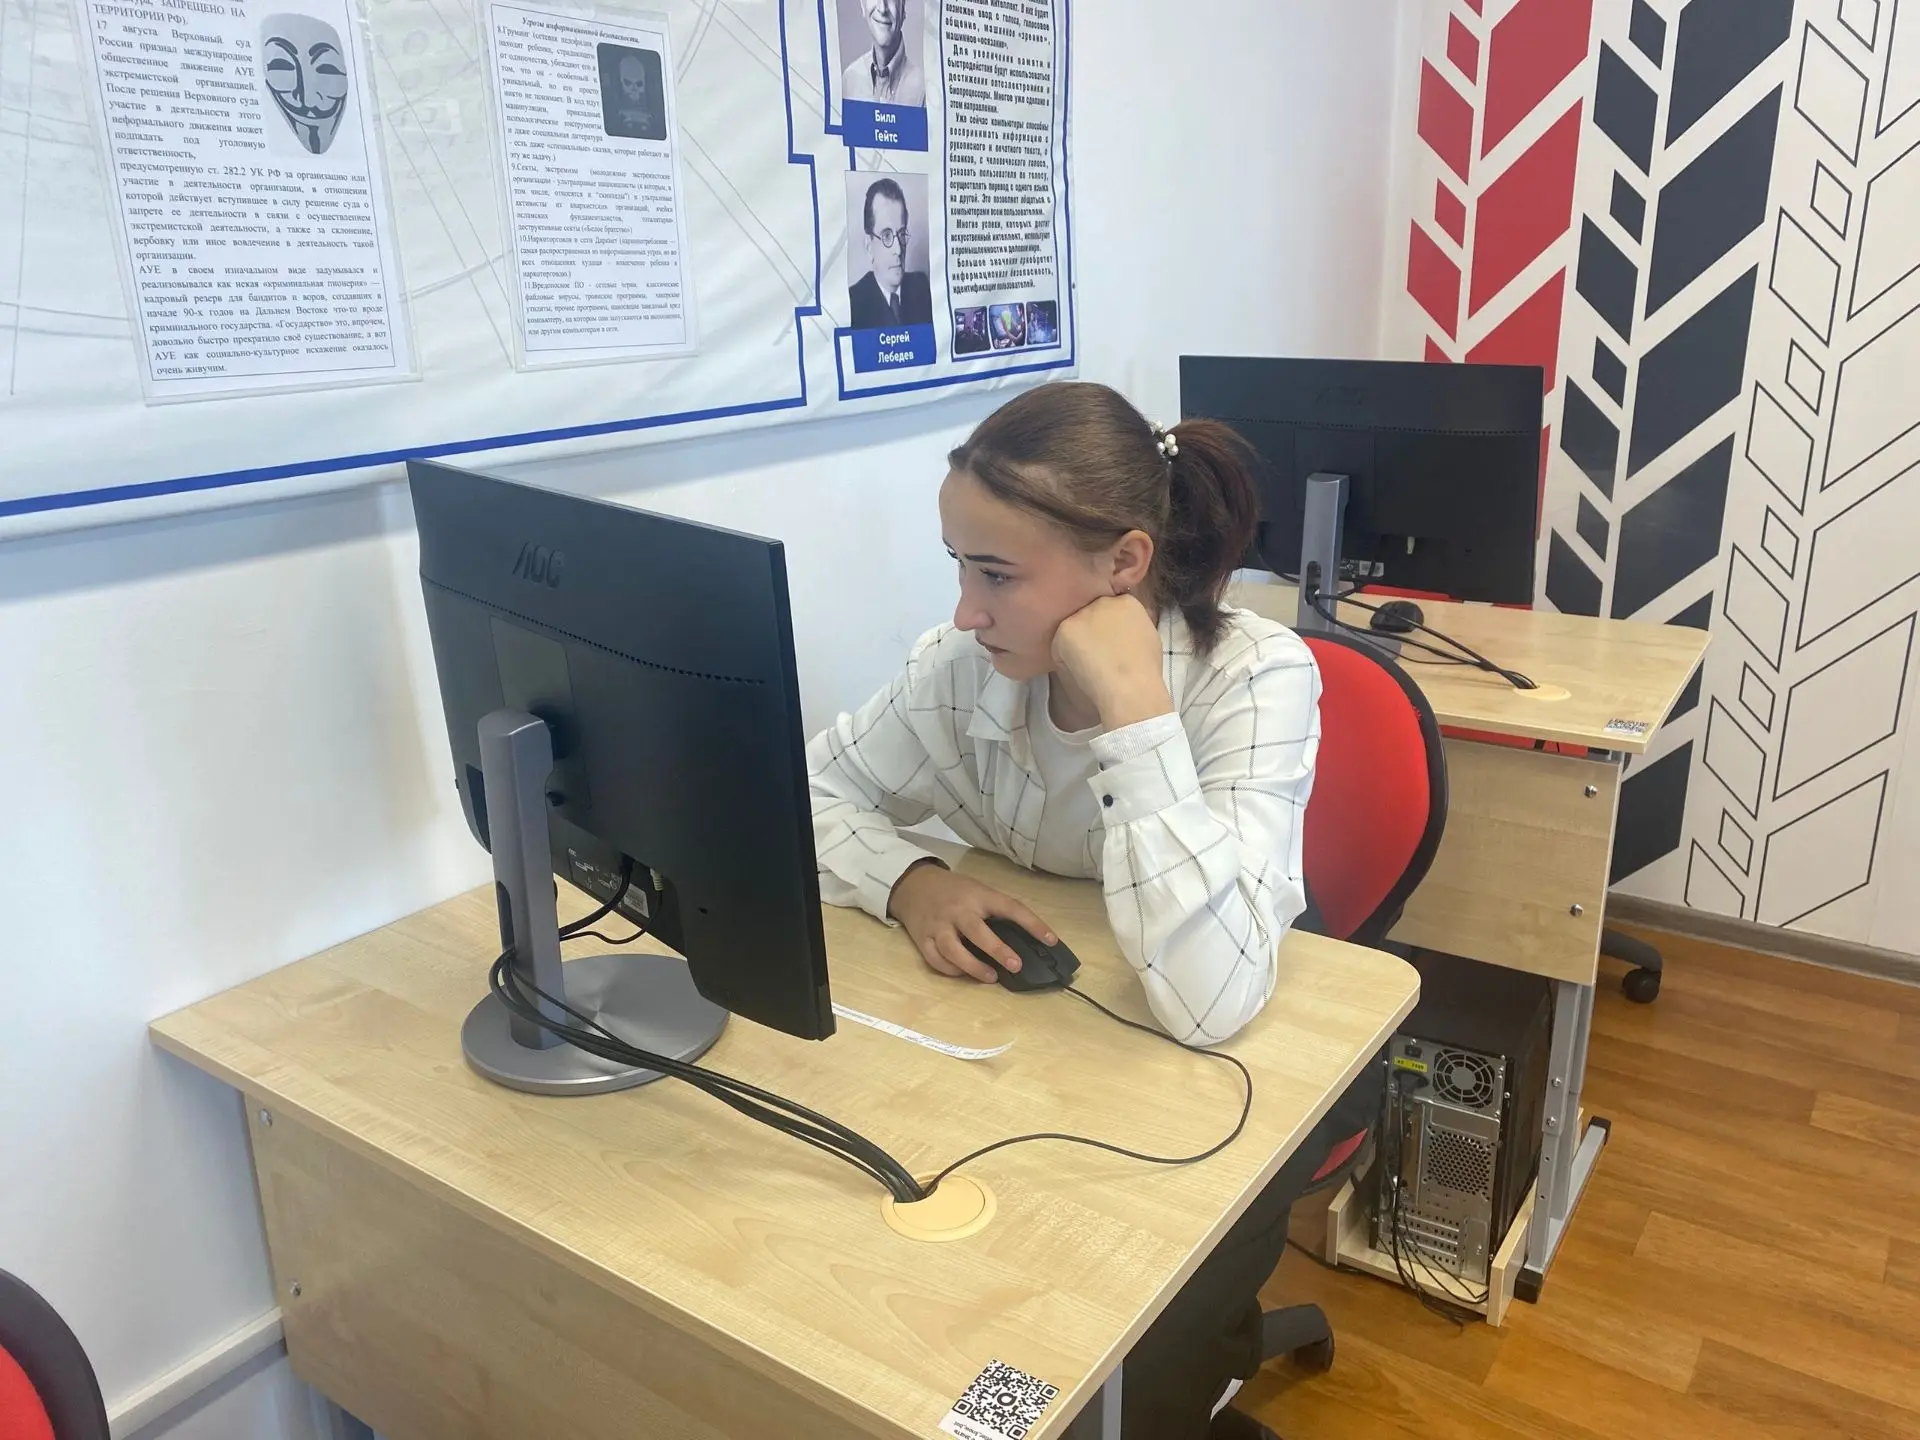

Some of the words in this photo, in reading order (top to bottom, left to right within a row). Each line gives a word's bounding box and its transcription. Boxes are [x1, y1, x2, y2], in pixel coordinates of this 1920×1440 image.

[93, 3, 165, 21] ТЕРРИТОРИИ
[122, 25, 158, 36] августа
[171, 28, 223, 43] Верховный
[235, 39, 250, 48] суд
[98, 35, 133, 48] России
[139, 42, 177, 53] признал
[183, 47, 253, 61] международное
[101, 52, 168, 67] общественное
[180, 62, 224, 73] движение
[234, 66, 254, 76] АУЕ
[195, 79, 256, 91] организацией.
[106, 81, 136, 93] После
[140, 87, 180, 97] решения
[183, 88, 236, 102] Верховного
[239, 96, 259, 105] суда
[109, 101, 147, 110] участие
[170, 106, 230, 117] деятельности
[874, 109, 896, 124] Билл
[112, 115, 185, 128] неформального
[189, 122, 232, 132] движения
[236, 126, 263, 134] может
[115, 132, 163, 142] подпадать
[183, 137, 200, 145] под
[219, 139, 265, 150] уголовную
[874, 128, 899, 143] Гейтс
[117, 146, 196, 158] ответственность,
[120, 162, 203, 174] предусмотренную
[223, 165, 246, 175] 282.2
[125, 191, 163, 202] которой
[169, 192, 212, 204] действует
[218, 196, 268, 205] вступившее
[280, 198, 301, 207] силу
[305, 199, 339, 208] решение
[343, 200, 360, 209] суда
[210, 224, 269, 233] деятельности,
[135, 251, 195, 261] организации.
[141, 280, 213, 290] реализовывался
[144, 292, 188, 304] кадровый
[194, 294, 222, 304] резерв
[228, 294, 243, 302] для
[248, 291, 287, 301] бандитов
[303, 293, 328, 302] воров,
[147, 309, 178, 317] начале
[183, 306, 203, 316] 90-х
[209, 308, 233, 316] годов
[255, 305, 290, 315] Дальнем
[296, 304, 328, 313] Востоке
[362, 305, 383, 314] вроде
[149, 323, 218, 333] криминального
[276, 318, 332, 329] «Государство»
[352, 318, 385, 327] впрочем,
[151, 337, 194, 347] довольно
[197, 334, 229, 345] быстро
[233, 334, 280, 344] прекратило
[283, 331, 301, 341] своё
[879, 330, 910, 347] Сергей
[154, 349, 176, 360] АУЕ
[184, 351, 199, 359] как
[206, 347, 299, 358] социально-культурное
[306, 345, 347, 353] искажение
[352, 343, 388, 351] оказалось
[877, 350, 914, 364] Лебедев
